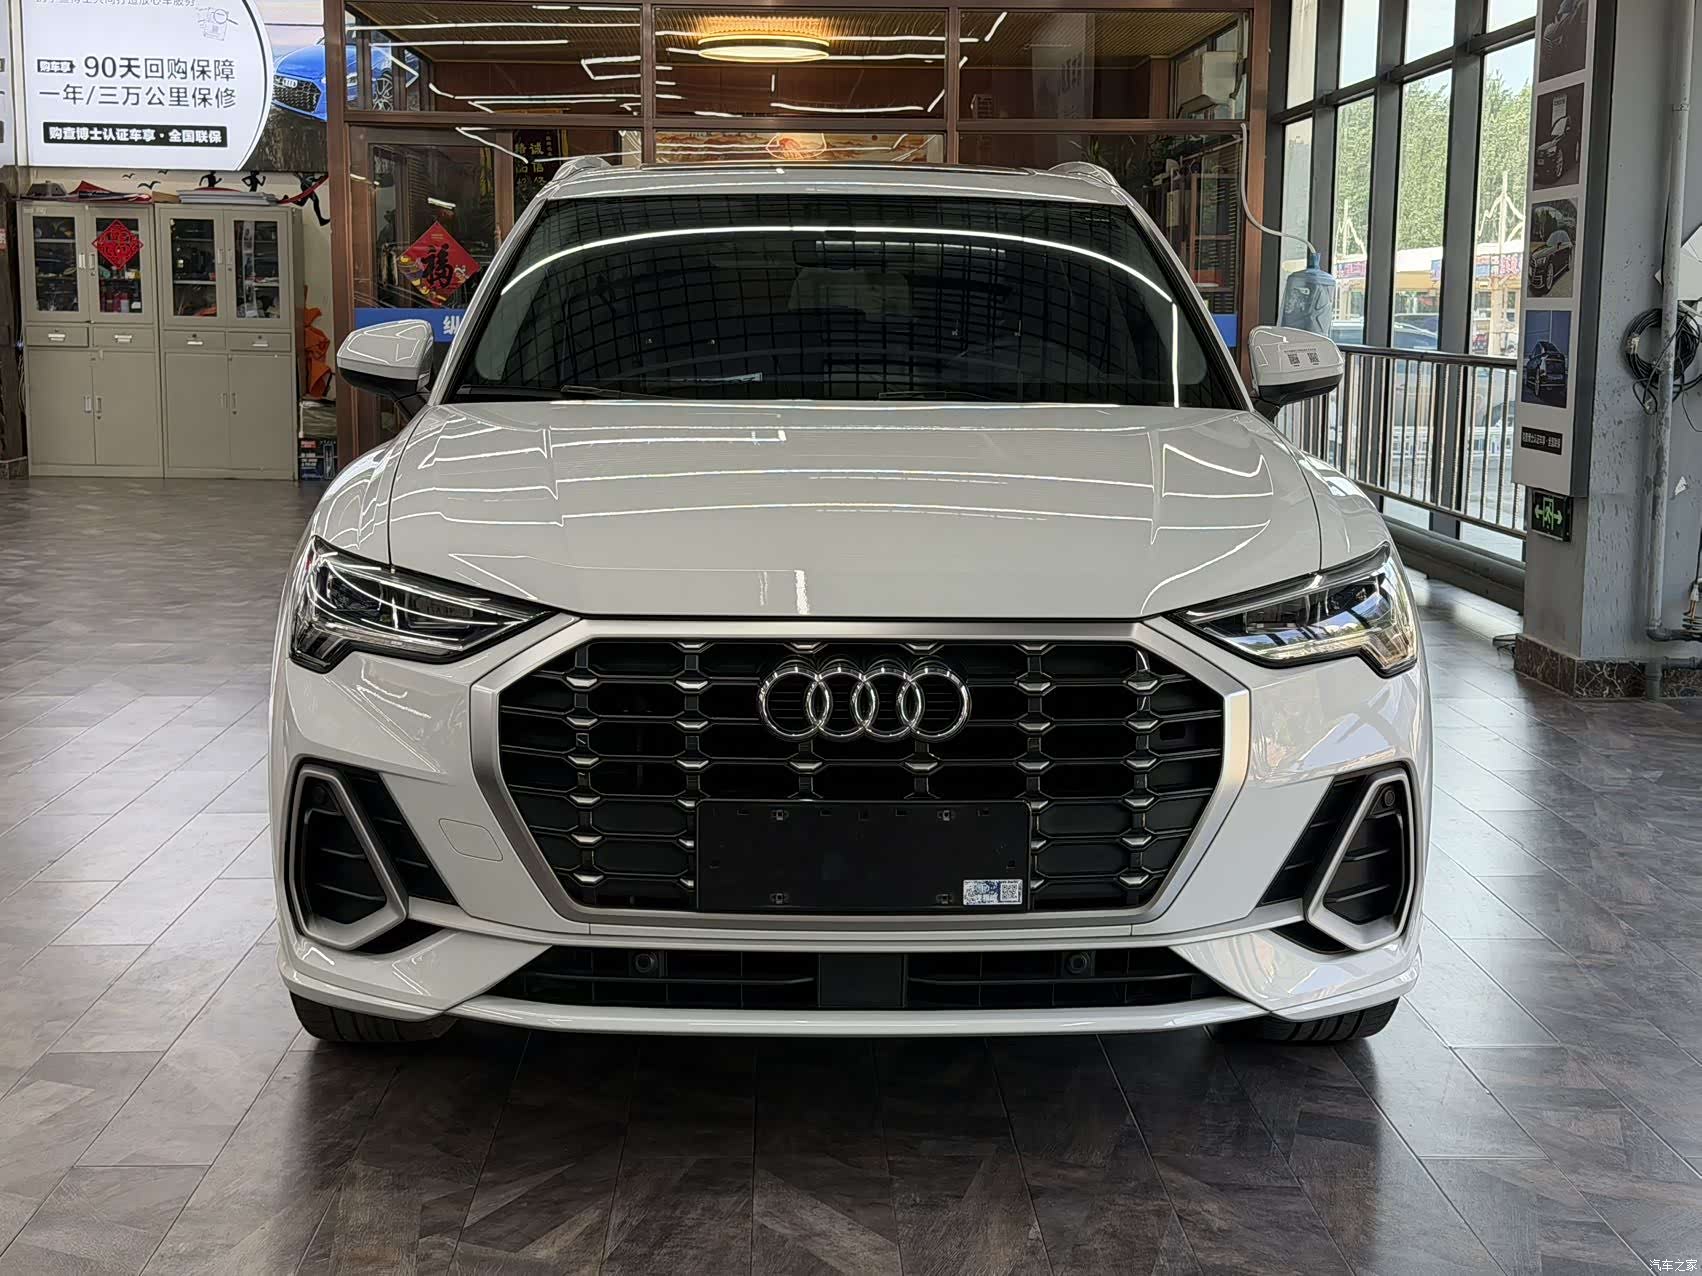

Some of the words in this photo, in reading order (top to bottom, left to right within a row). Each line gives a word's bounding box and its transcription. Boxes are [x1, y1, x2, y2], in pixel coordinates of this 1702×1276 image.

[84, 55, 235, 81] 90天回购保障
[39, 84, 236, 108] 一年/三万公里保修
[421, 243, 454, 289] 福
